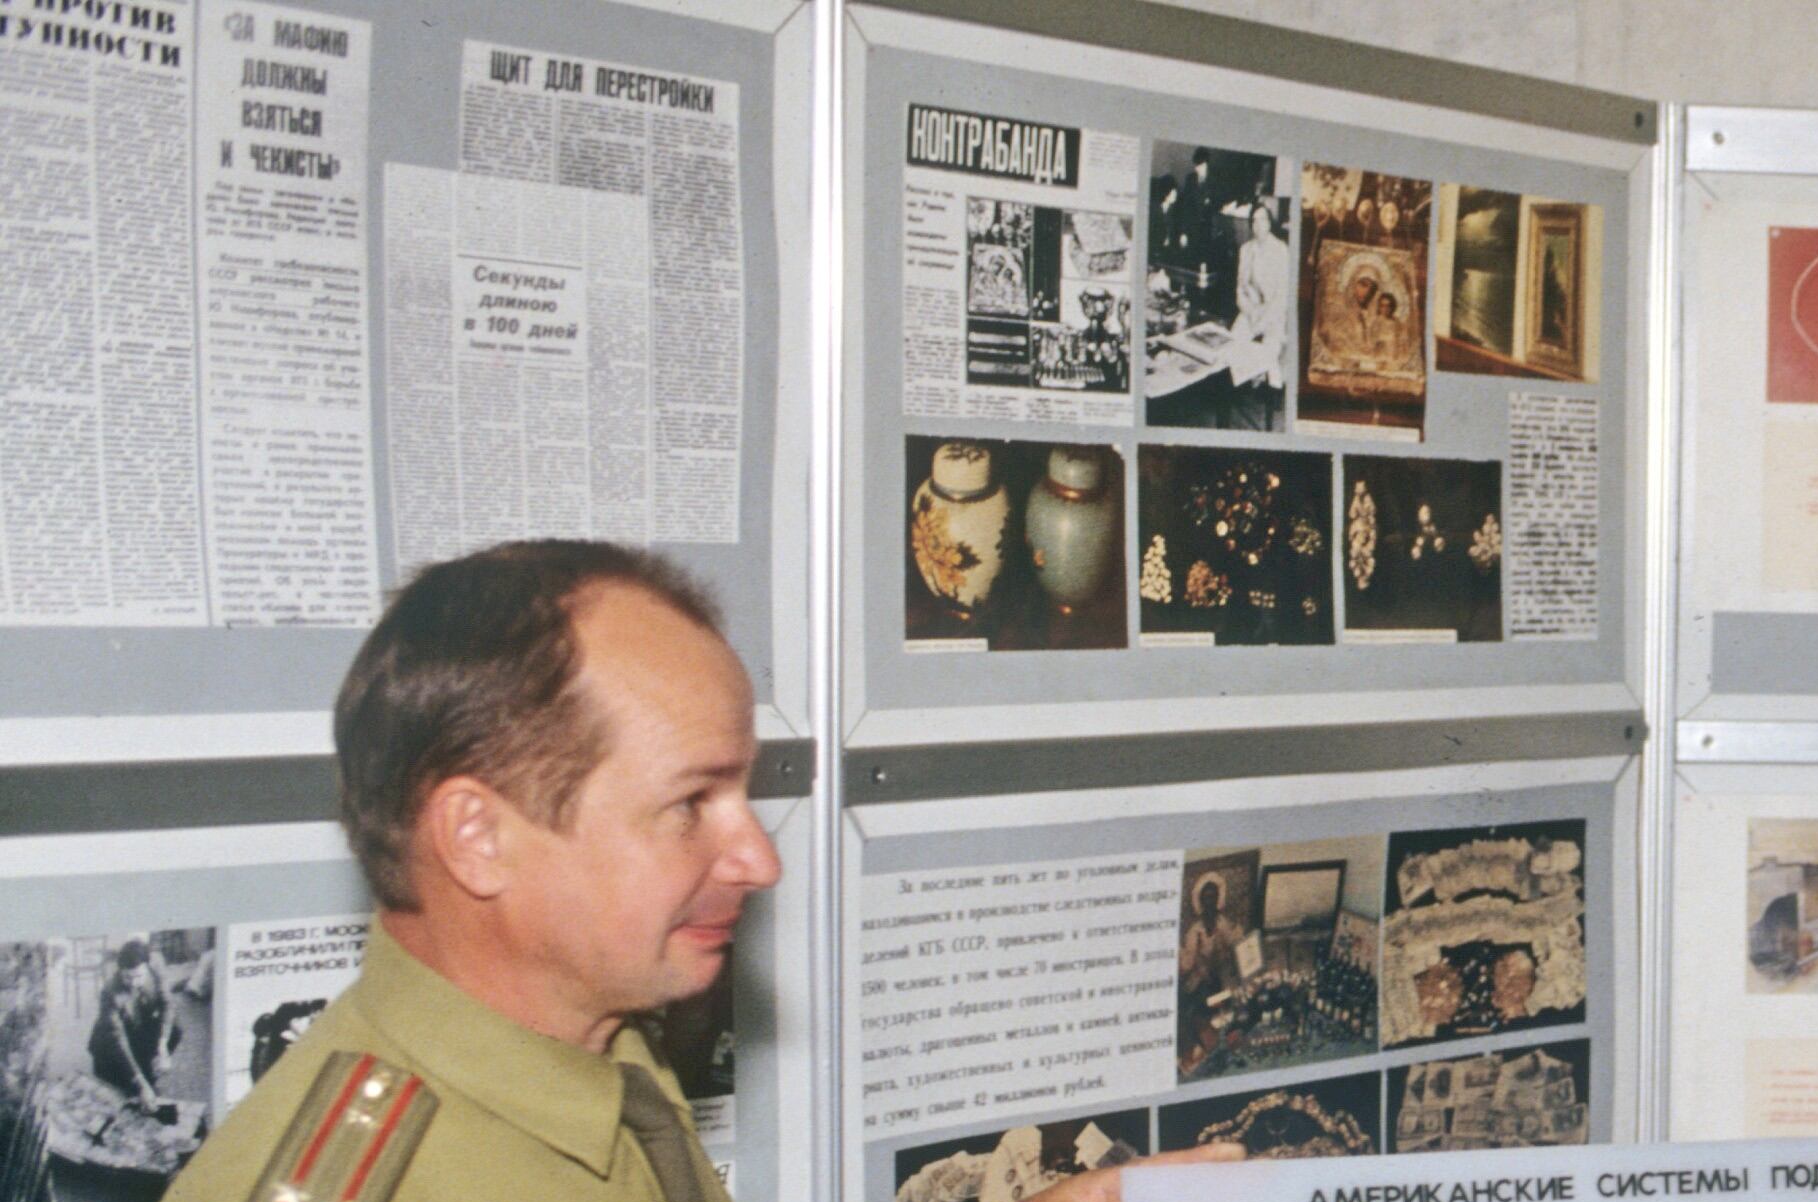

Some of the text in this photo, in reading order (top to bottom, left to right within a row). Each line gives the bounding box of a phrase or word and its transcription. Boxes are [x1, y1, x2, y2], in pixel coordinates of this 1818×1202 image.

[274, 20, 348, 58] МАФИЮ
[241, 58, 328, 95] ДОЛЖНЫ
[490, 50, 714, 113] ЩИТ ДЛЯ ПЕРЕСТРОЙКИ
[242, 100, 322, 137] ВЗЯТЬСЯ
[220, 140, 341, 179] И ЧЕКИСТЫ»
[910, 107, 1067, 186] КОНТРАБАНДА
[473, 264, 566, 291] Секунды
[478, 294, 558, 313] длиною
[464, 316, 578, 339] в 100 дней
[918, 939, 945, 956] КГБ
[1596, 1167, 1749, 1198] СИСТЕМЫ
